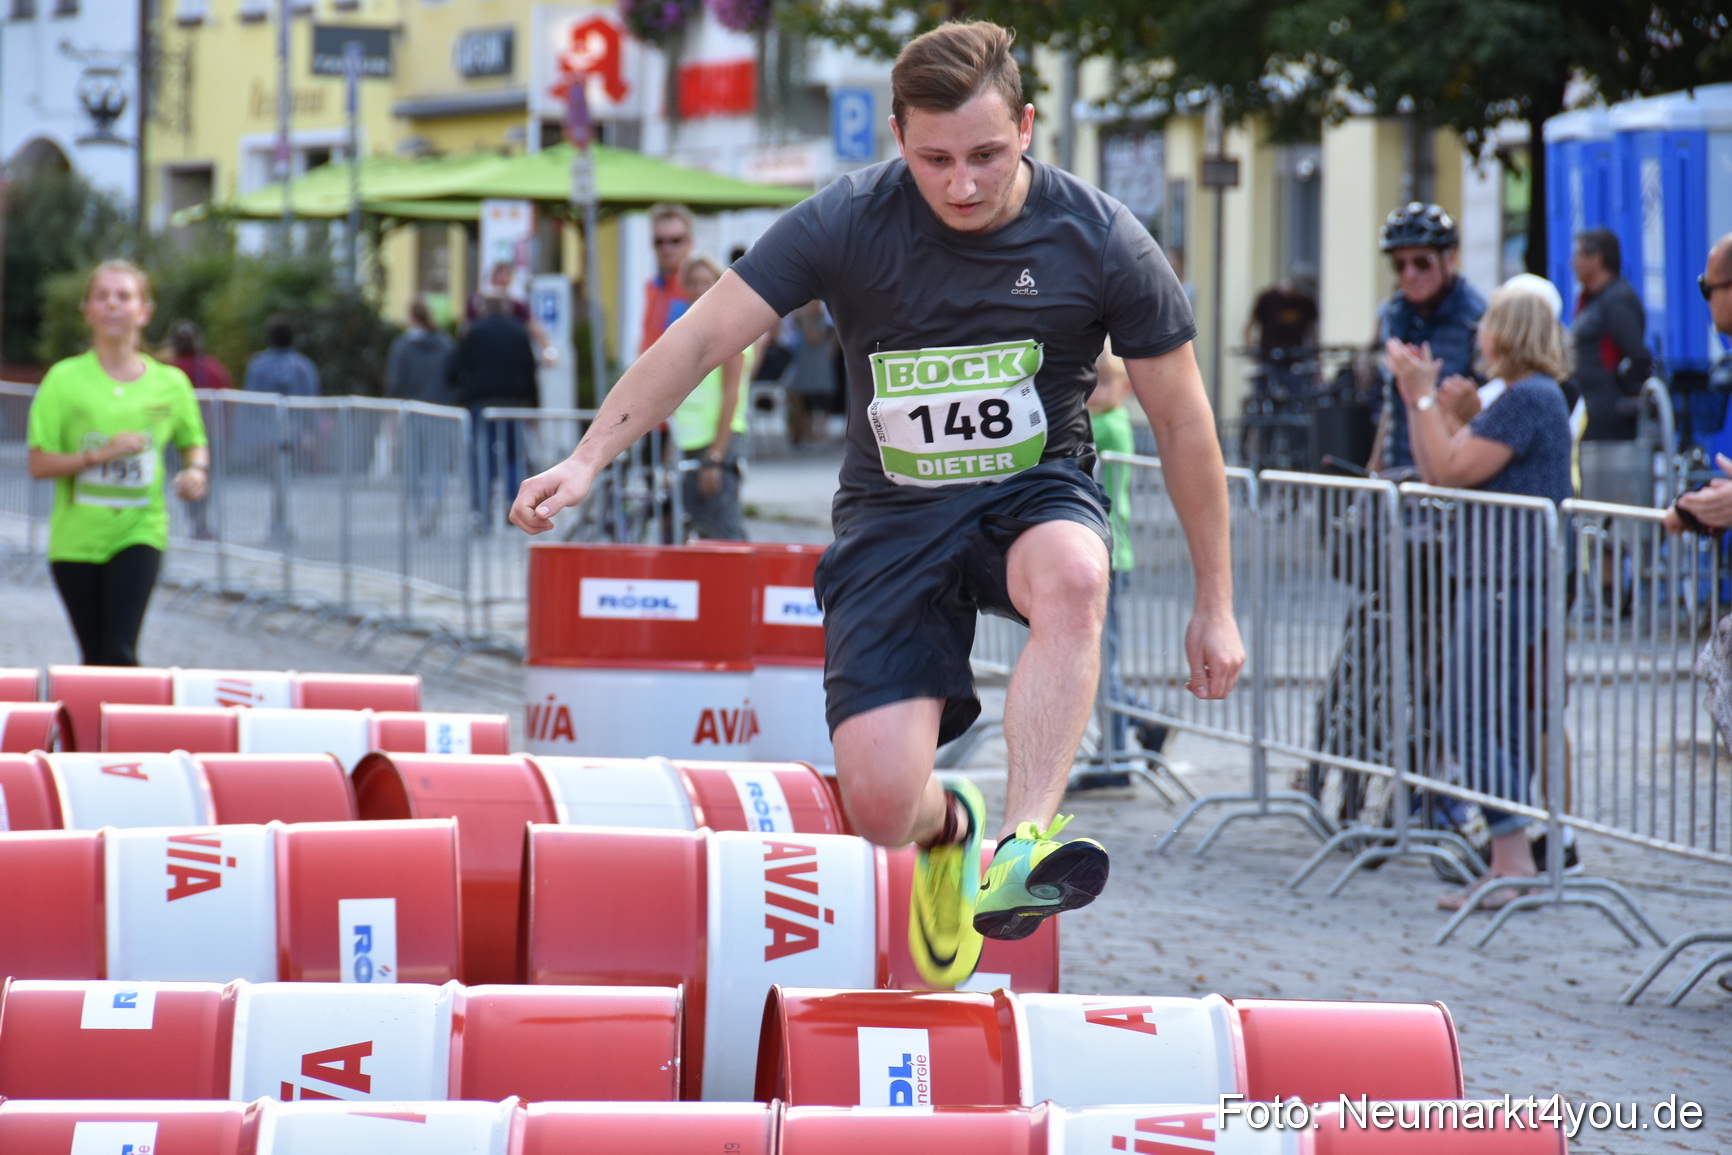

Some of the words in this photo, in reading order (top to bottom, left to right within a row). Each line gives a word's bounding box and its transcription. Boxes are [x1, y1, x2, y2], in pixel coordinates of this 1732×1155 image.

[885, 347, 1028, 392] BOCK
[908, 398, 1013, 443] 148
[916, 452, 1015, 475] DIETER
